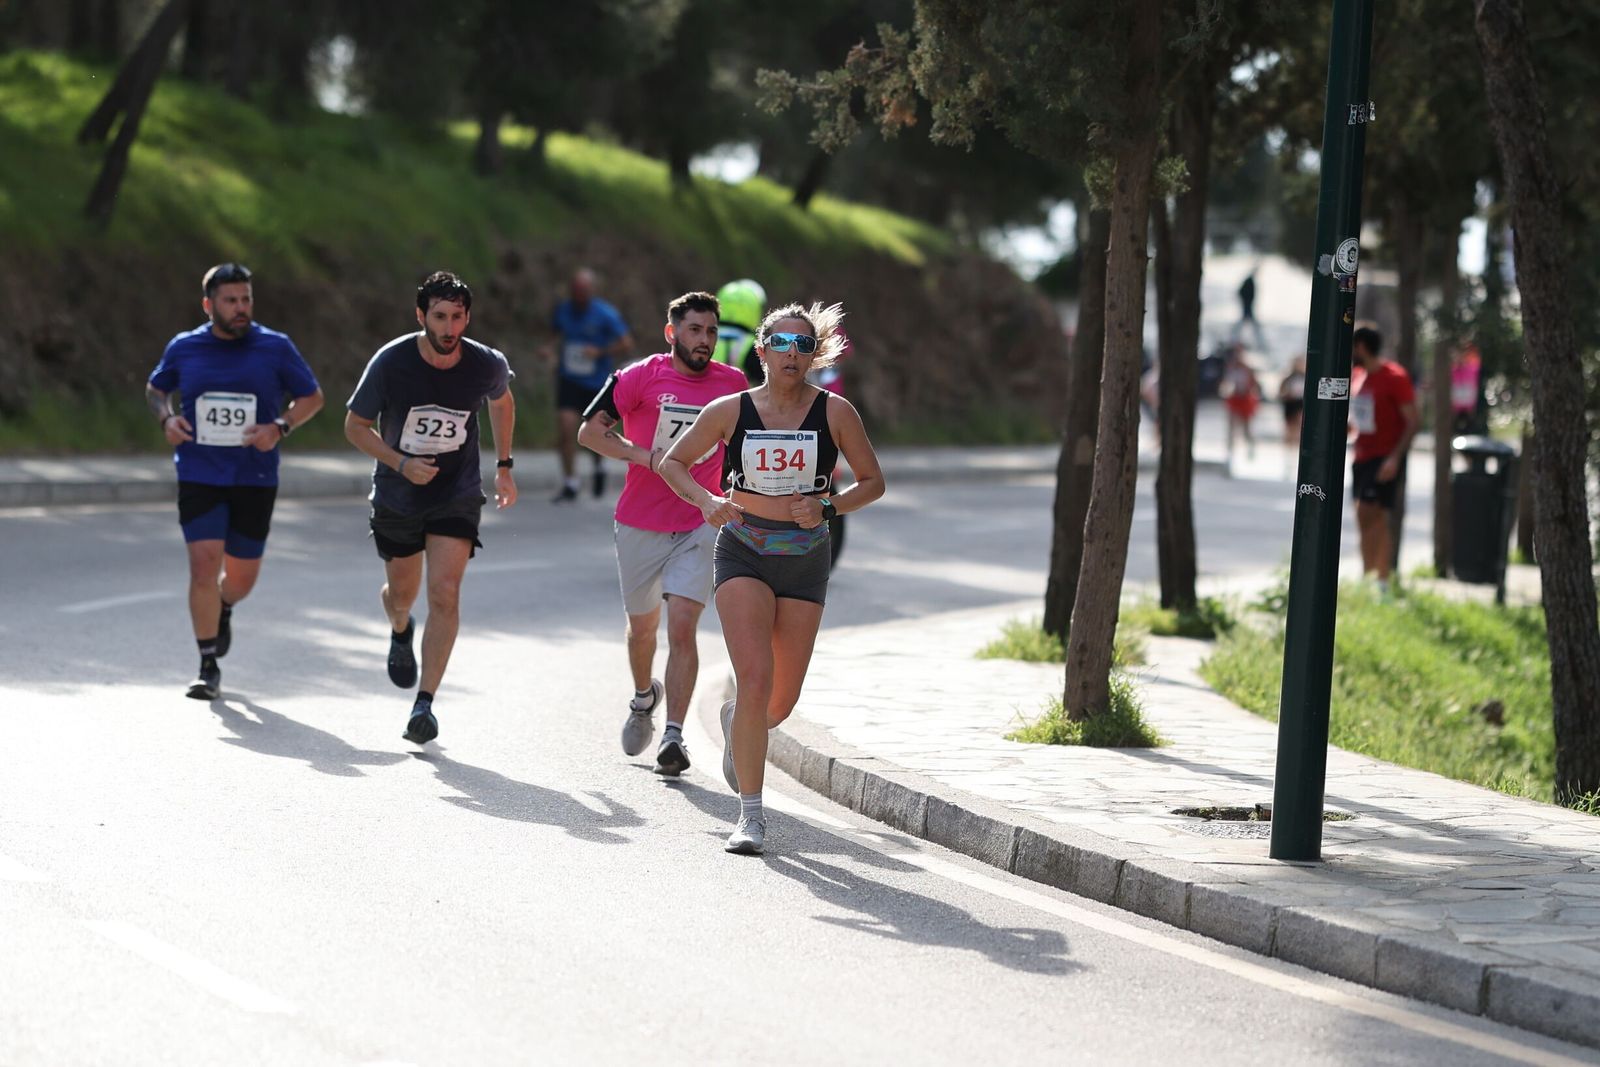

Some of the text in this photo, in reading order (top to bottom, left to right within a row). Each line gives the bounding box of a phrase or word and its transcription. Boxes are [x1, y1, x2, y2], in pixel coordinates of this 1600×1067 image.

[206, 407, 246, 426] 439
[415, 417, 457, 439] 523
[755, 448, 806, 472] 134
